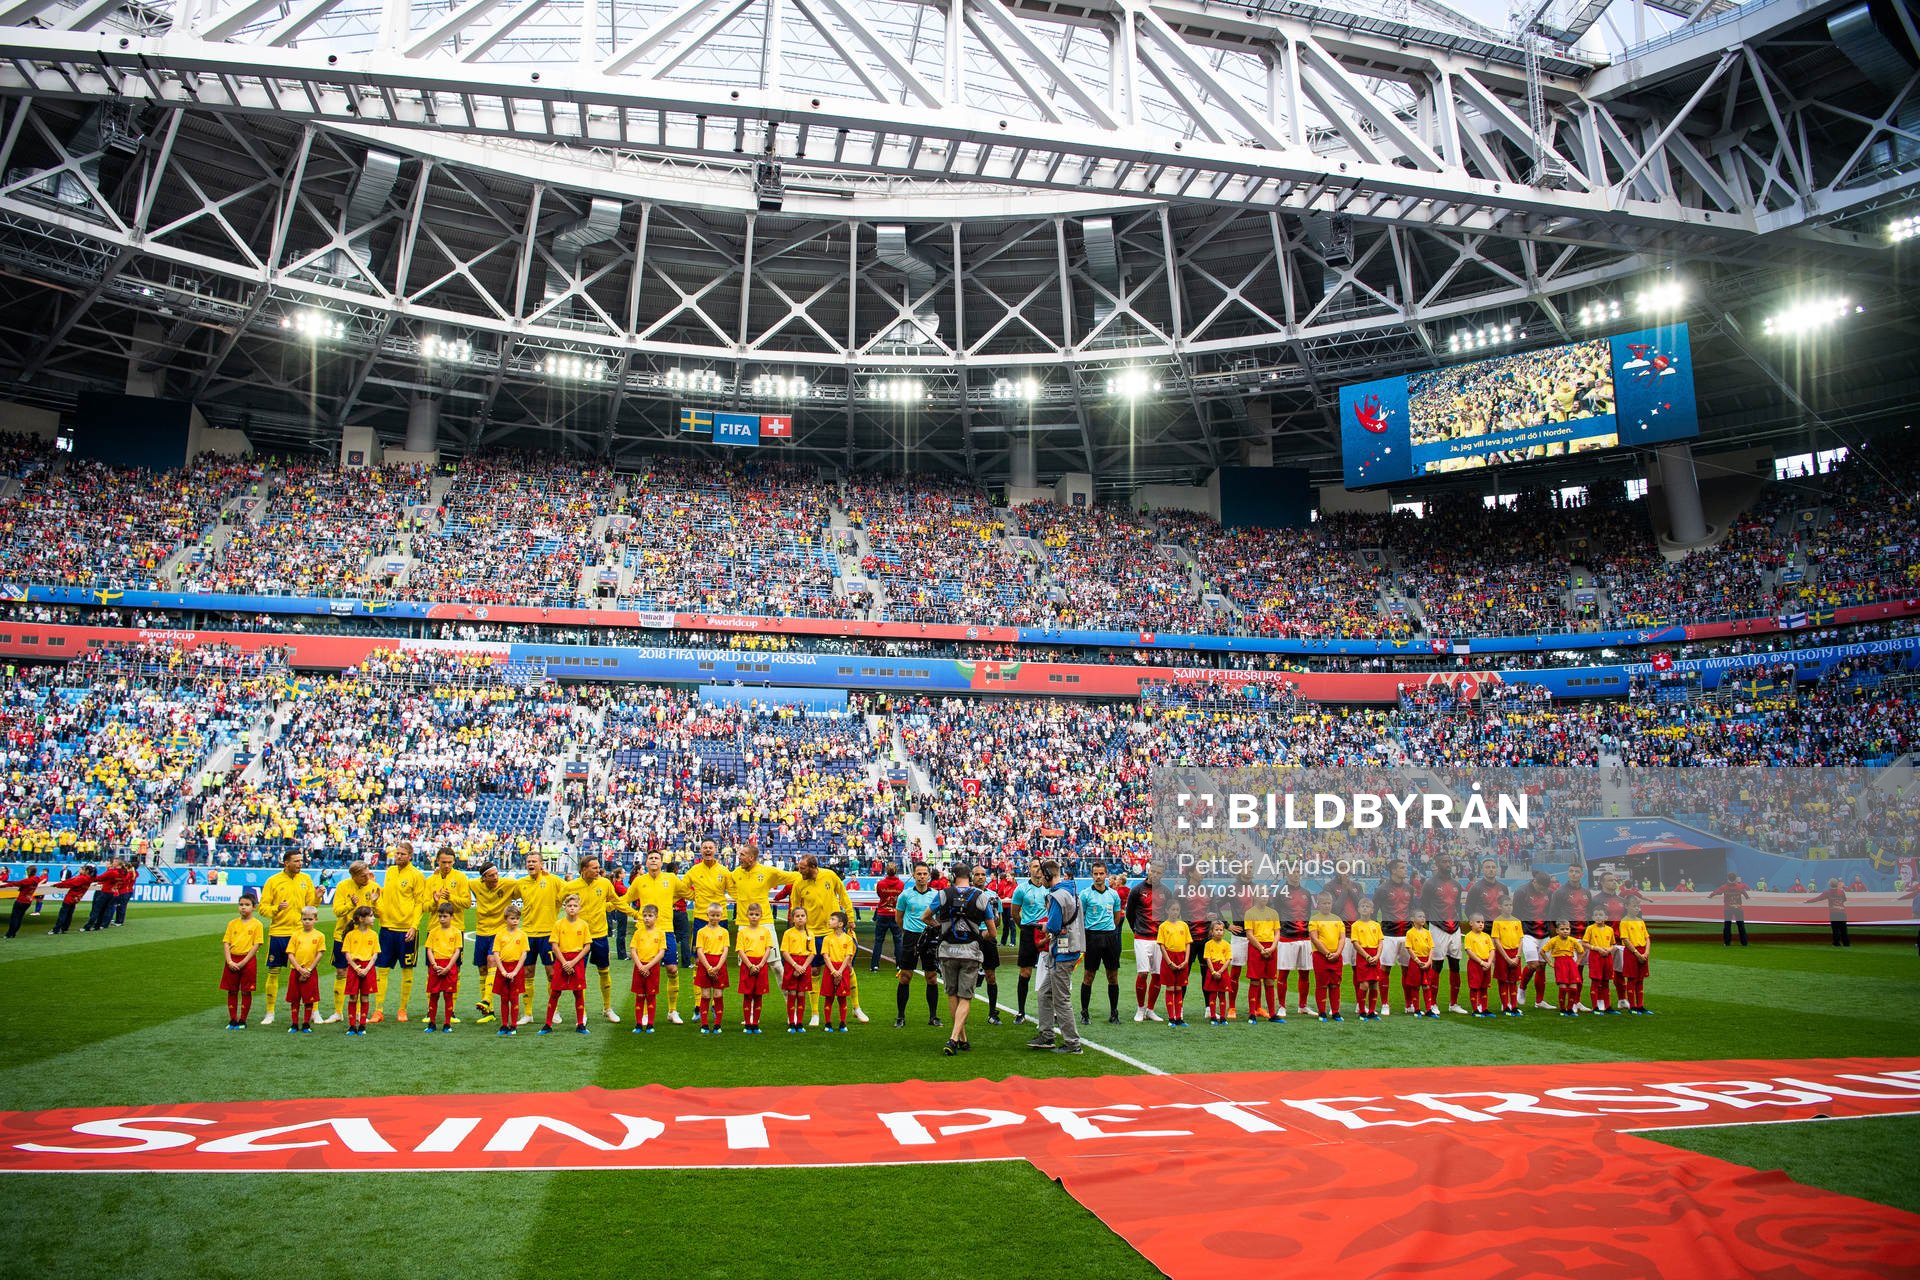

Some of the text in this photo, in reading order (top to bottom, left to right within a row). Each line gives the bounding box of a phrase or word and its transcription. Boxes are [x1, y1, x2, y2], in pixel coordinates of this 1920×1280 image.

[720, 423, 752, 436] FIFA
[1501, 437, 1513, 445] jag
[1543, 428, 1573, 437] Norden.
[708, 618, 759, 629] #worldcup
[139, 630, 195, 642] #worldcup
[638, 649, 817, 665] 2018 FIFA WORLD CUP RUSSIA
[1623, 660, 1703, 675] ЧЕМОНАТ
[1705, 656, 1745, 669] МИРА
[1747, 655, 1767, 665] ПО
[1770, 646, 1834, 664] ФУТБОЛУ
[1838, 644, 1867, 657] FIFA
[1870, 640, 1902, 653] 2018
[1173, 668, 1282, 681] SAINT PETERSBURG
[130, 884, 174, 902] PROM
[14, 1112, 810, 1153] SAINT
